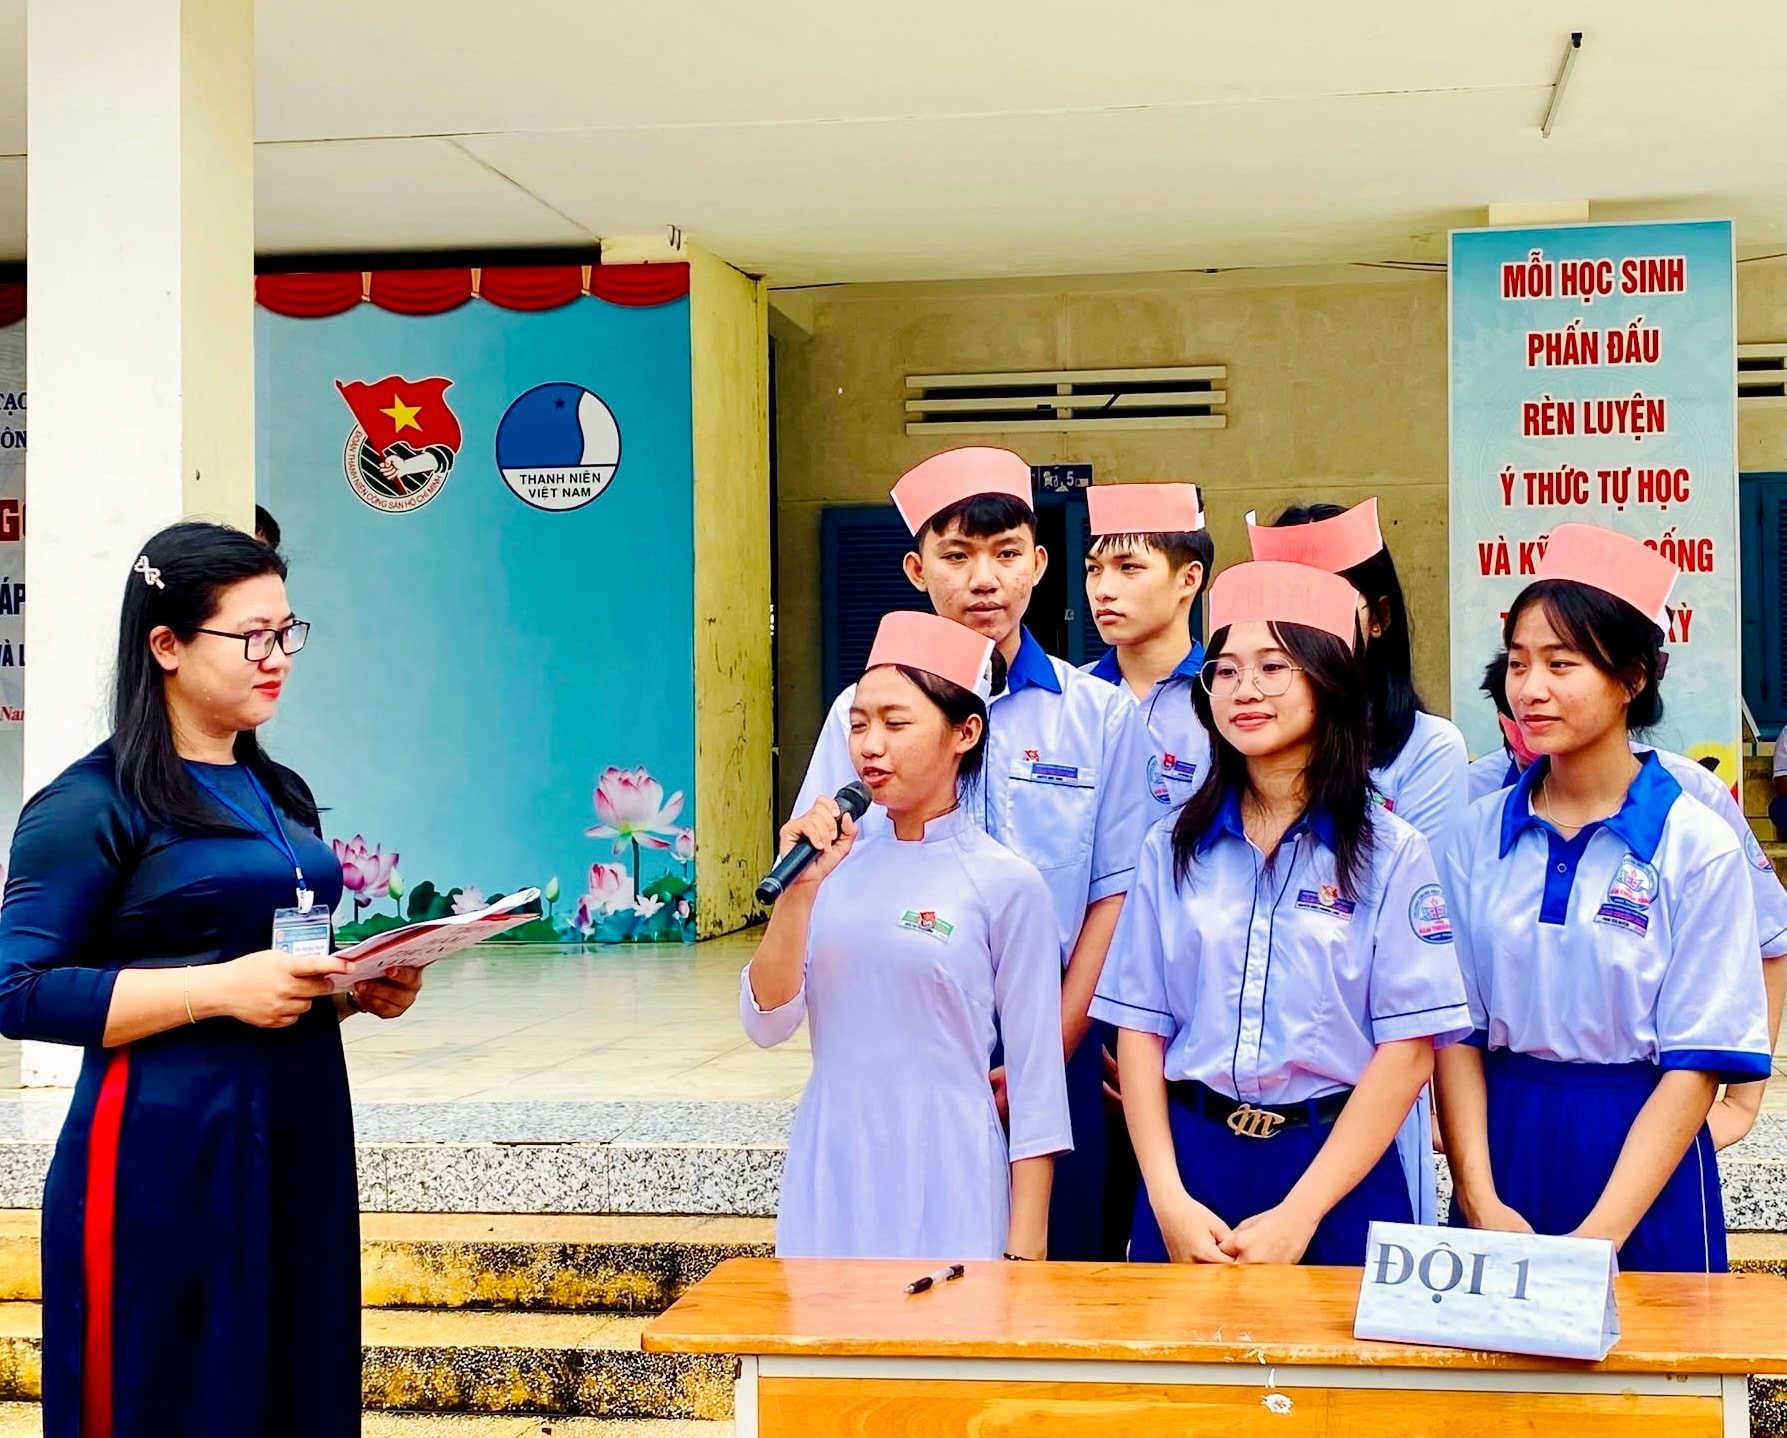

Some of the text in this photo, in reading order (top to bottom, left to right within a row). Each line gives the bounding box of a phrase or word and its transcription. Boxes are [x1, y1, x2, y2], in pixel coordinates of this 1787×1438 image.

[1503, 251, 1684, 303] MỖI HỌC SINH
[1528, 317, 1659, 367] PHẤN ĐẤU
[1523, 392, 1665, 441] RÈN LUYỆN
[519, 470, 601, 485] THANH NIÊN
[528, 486, 591, 500] VIỆT NAM
[1500, 464, 1690, 511] Ý THỨC TỰ HỌC
[0, 499, 26, 541] G
[1478, 535, 1511, 576] VÀ
[1643, 526, 1713, 573] ỐNG
[0, 639, 14, 667] À
[1371, 1241, 1531, 1304] ĐỘI 1
